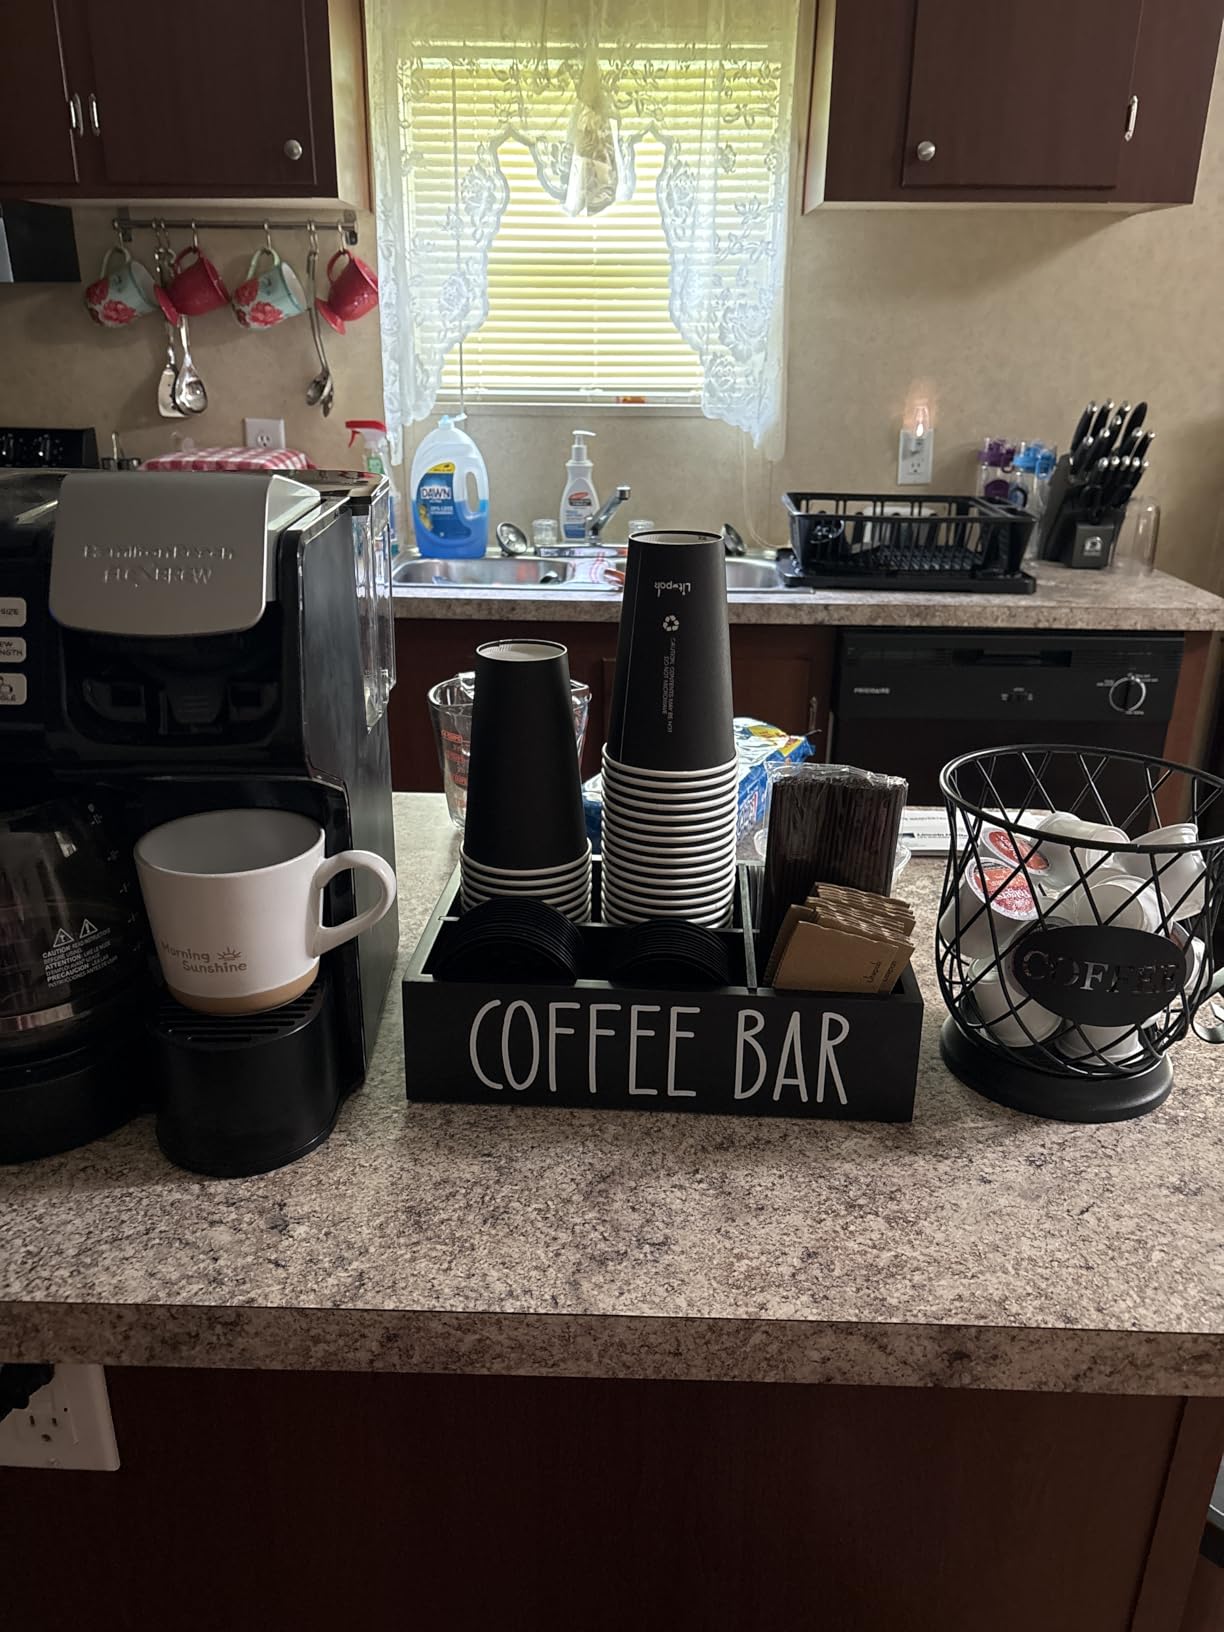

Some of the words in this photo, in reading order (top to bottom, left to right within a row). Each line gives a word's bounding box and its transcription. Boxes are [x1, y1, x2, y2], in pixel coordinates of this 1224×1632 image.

[422, 487, 451, 498] DAWN
[161, 941, 210, 964] Morning
[182, 960, 247, 974] Sunshine
[469, 999, 700, 1097] COFFEE
[734, 1008, 849, 1104] BAR
